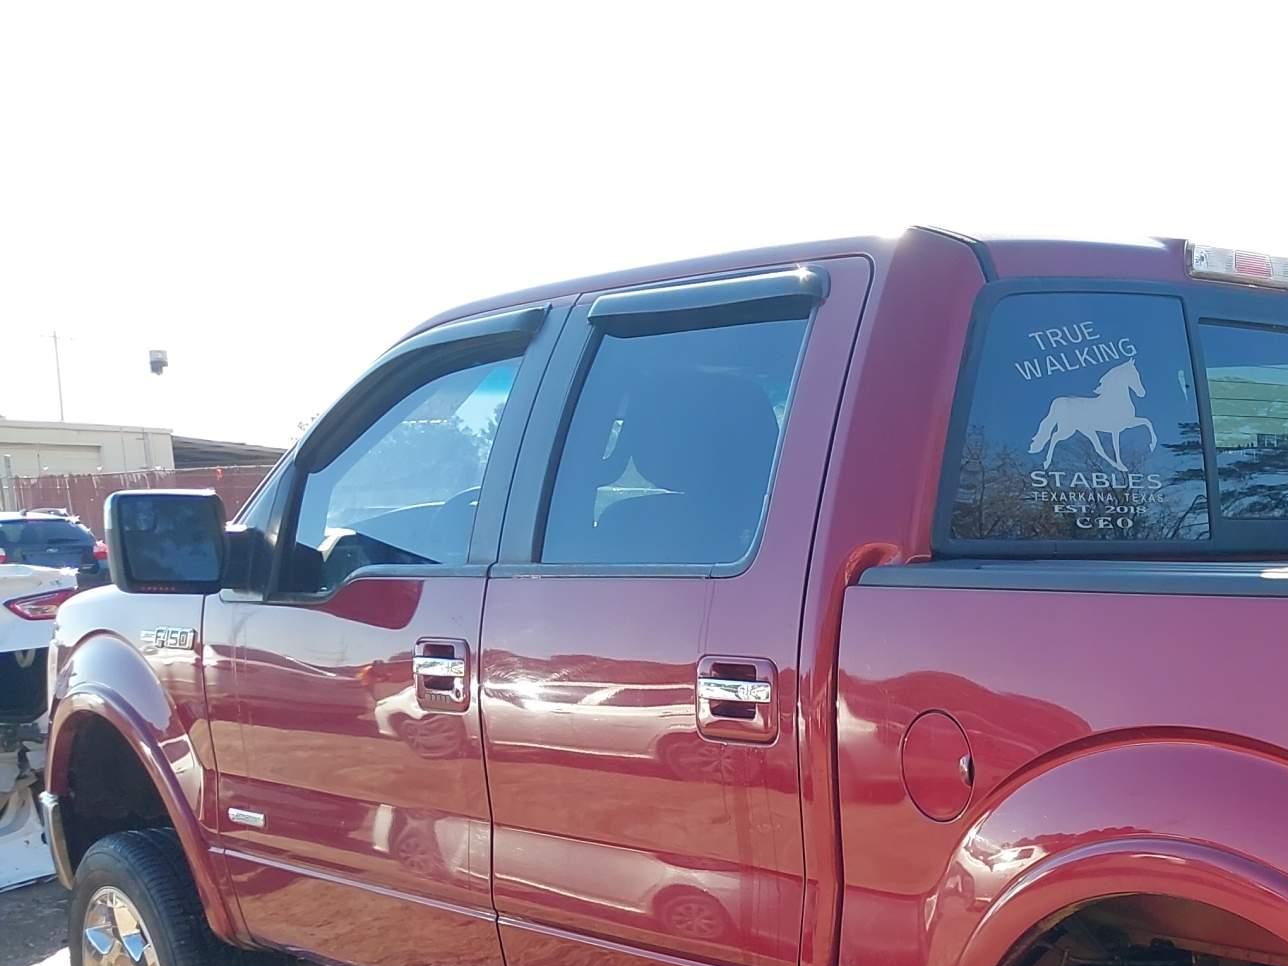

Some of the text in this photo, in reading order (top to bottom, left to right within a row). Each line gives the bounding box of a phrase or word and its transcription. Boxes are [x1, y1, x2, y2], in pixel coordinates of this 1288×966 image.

[1028, 321, 1100, 350] TRUE
[1014, 337, 1138, 381] WALKING
[1030, 470, 1163, 489] STABLES
[1124, 492, 1164, 503] TEXAS
[1054, 504, 1147, 514] EST. 2018
[1076, 516, 1134, 529] CEO
